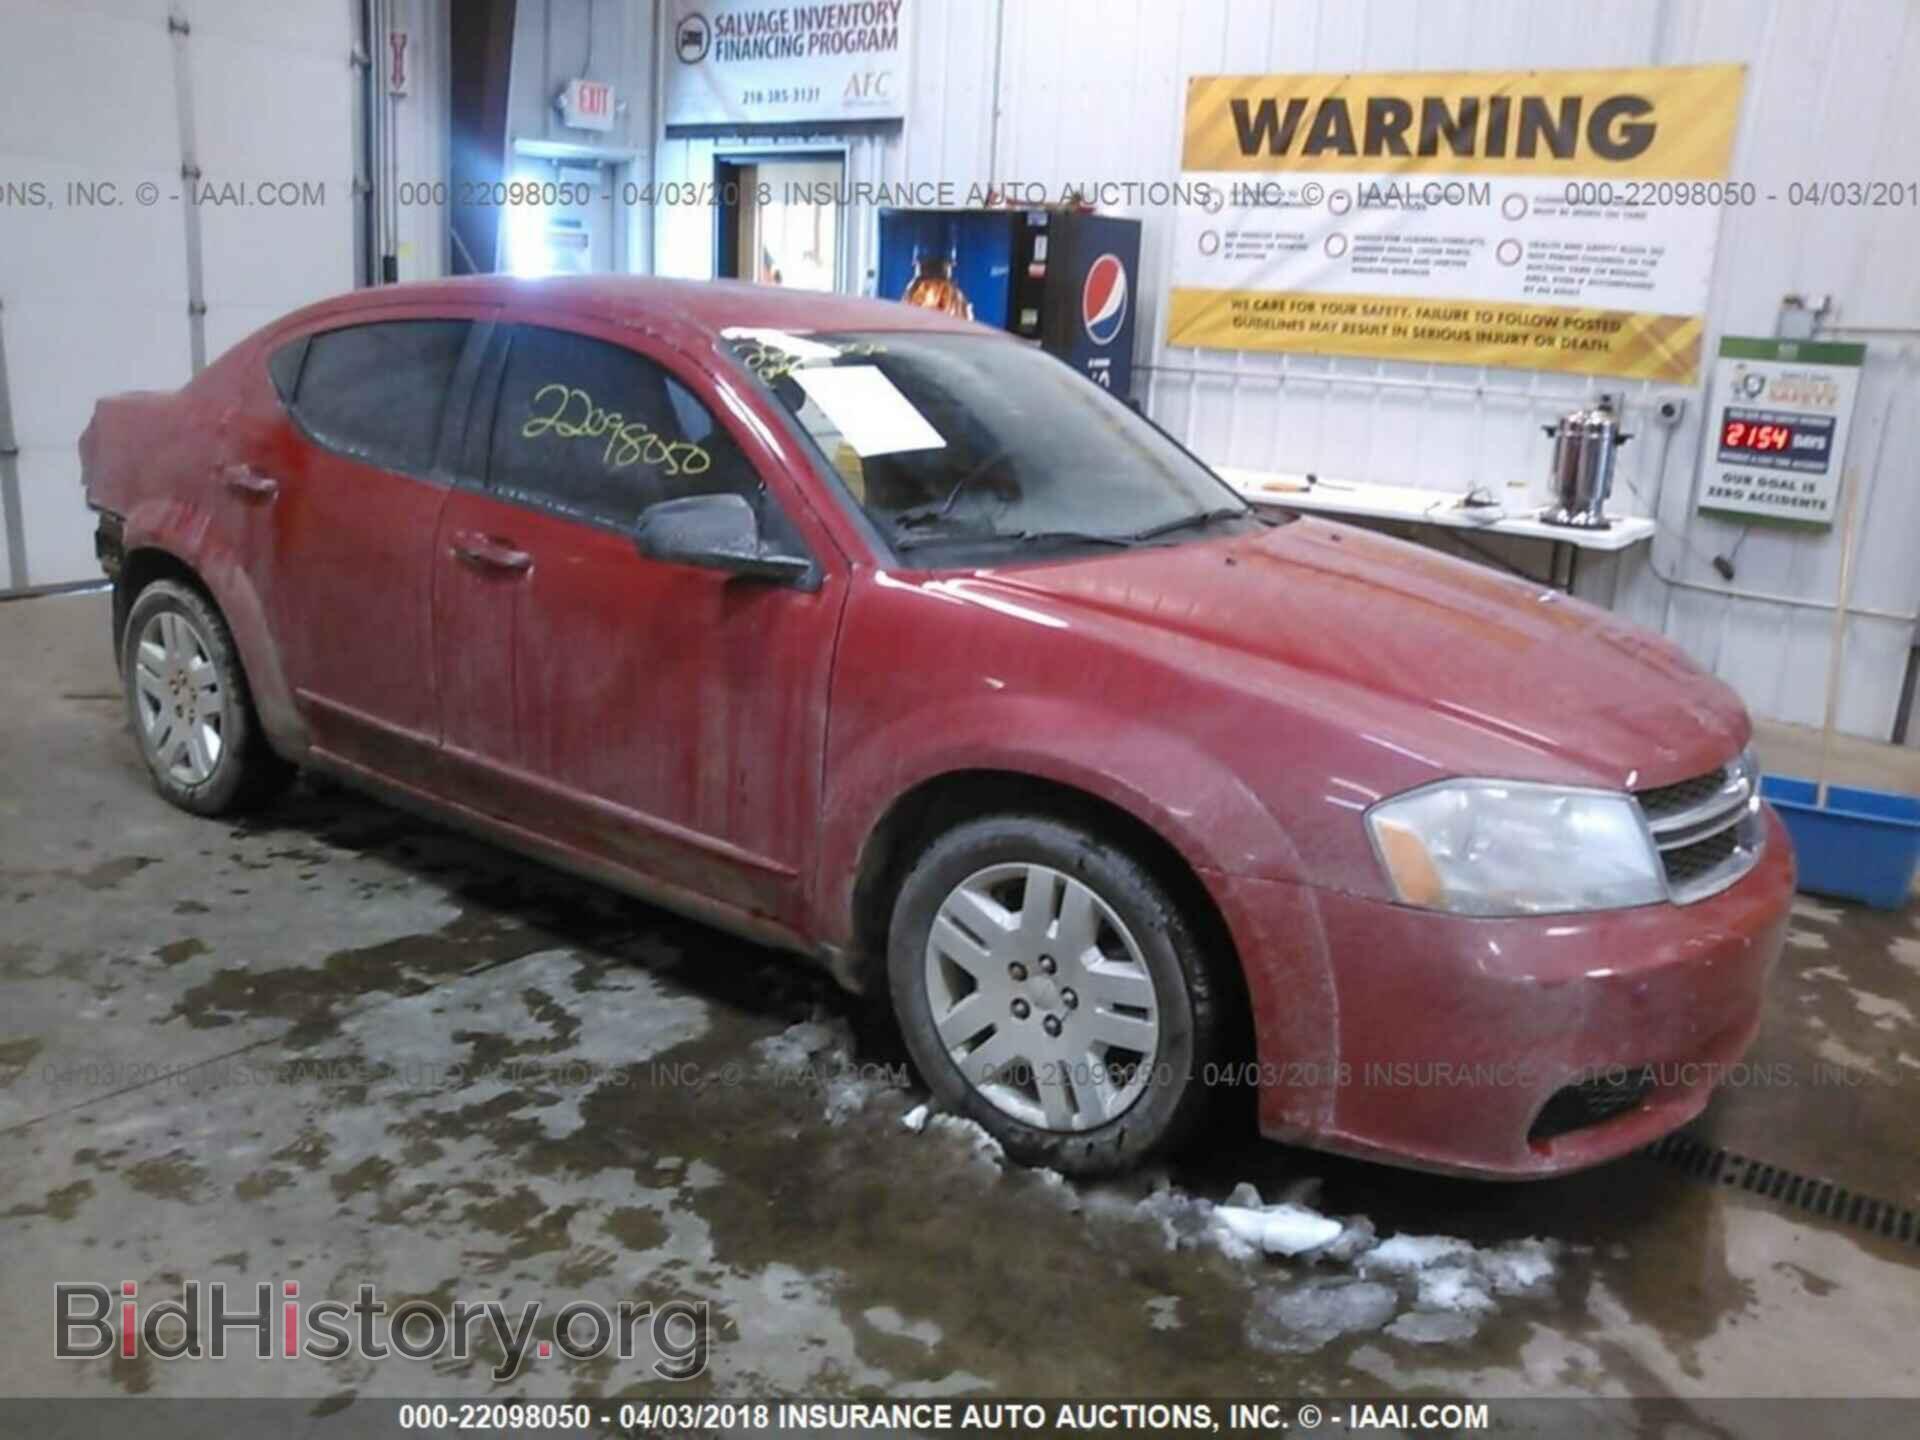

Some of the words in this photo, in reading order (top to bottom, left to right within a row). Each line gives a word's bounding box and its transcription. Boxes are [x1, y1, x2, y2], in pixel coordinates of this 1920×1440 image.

[715, 10, 789, 37] SALVAGE
[794, 0, 902, 29] INVENTORY
[716, 34, 805, 62] FINANCING
[808, 27, 899, 55] PROGRAM
[578, 82, 610, 116] EXIT
[1230, 94, 1657, 162] WARNING
[1232, 316, 1305, 331] GUIDELINES
[1309, 320, 1338, 332] MAY
[1342, 322, 1388, 337] RESULT
[1392, 325, 1407, 336] IN
[1413, 326, 1471, 342] SERIOUS
[1475, 330, 1529, 346] INJURY
[1534, 334, 1556, 347] OR
[1253, 299, 1285, 313] CARE
[1289, 301, 1315, 314] FOR
[1321, 302, 1357, 315] YOUR
[1416, 306, 1469, 322] FAILURE
[1475, 310, 1493, 322] TO
[1497, 311, 1559, 328] FOLLOW
[1563, 316, 1622, 333] POSTED
[522, 384, 711, 475] 22098050
[1725, 422, 1789, 451] 2154
[1707, 485, 1744, 501] ZERO
[1748, 488, 1827, 511] ACCIDENTS
[1722, 472, 1753, 486] OUR
[1757, 475, 1796, 492] GOAL
[1802, 480, 1816, 494] IS
